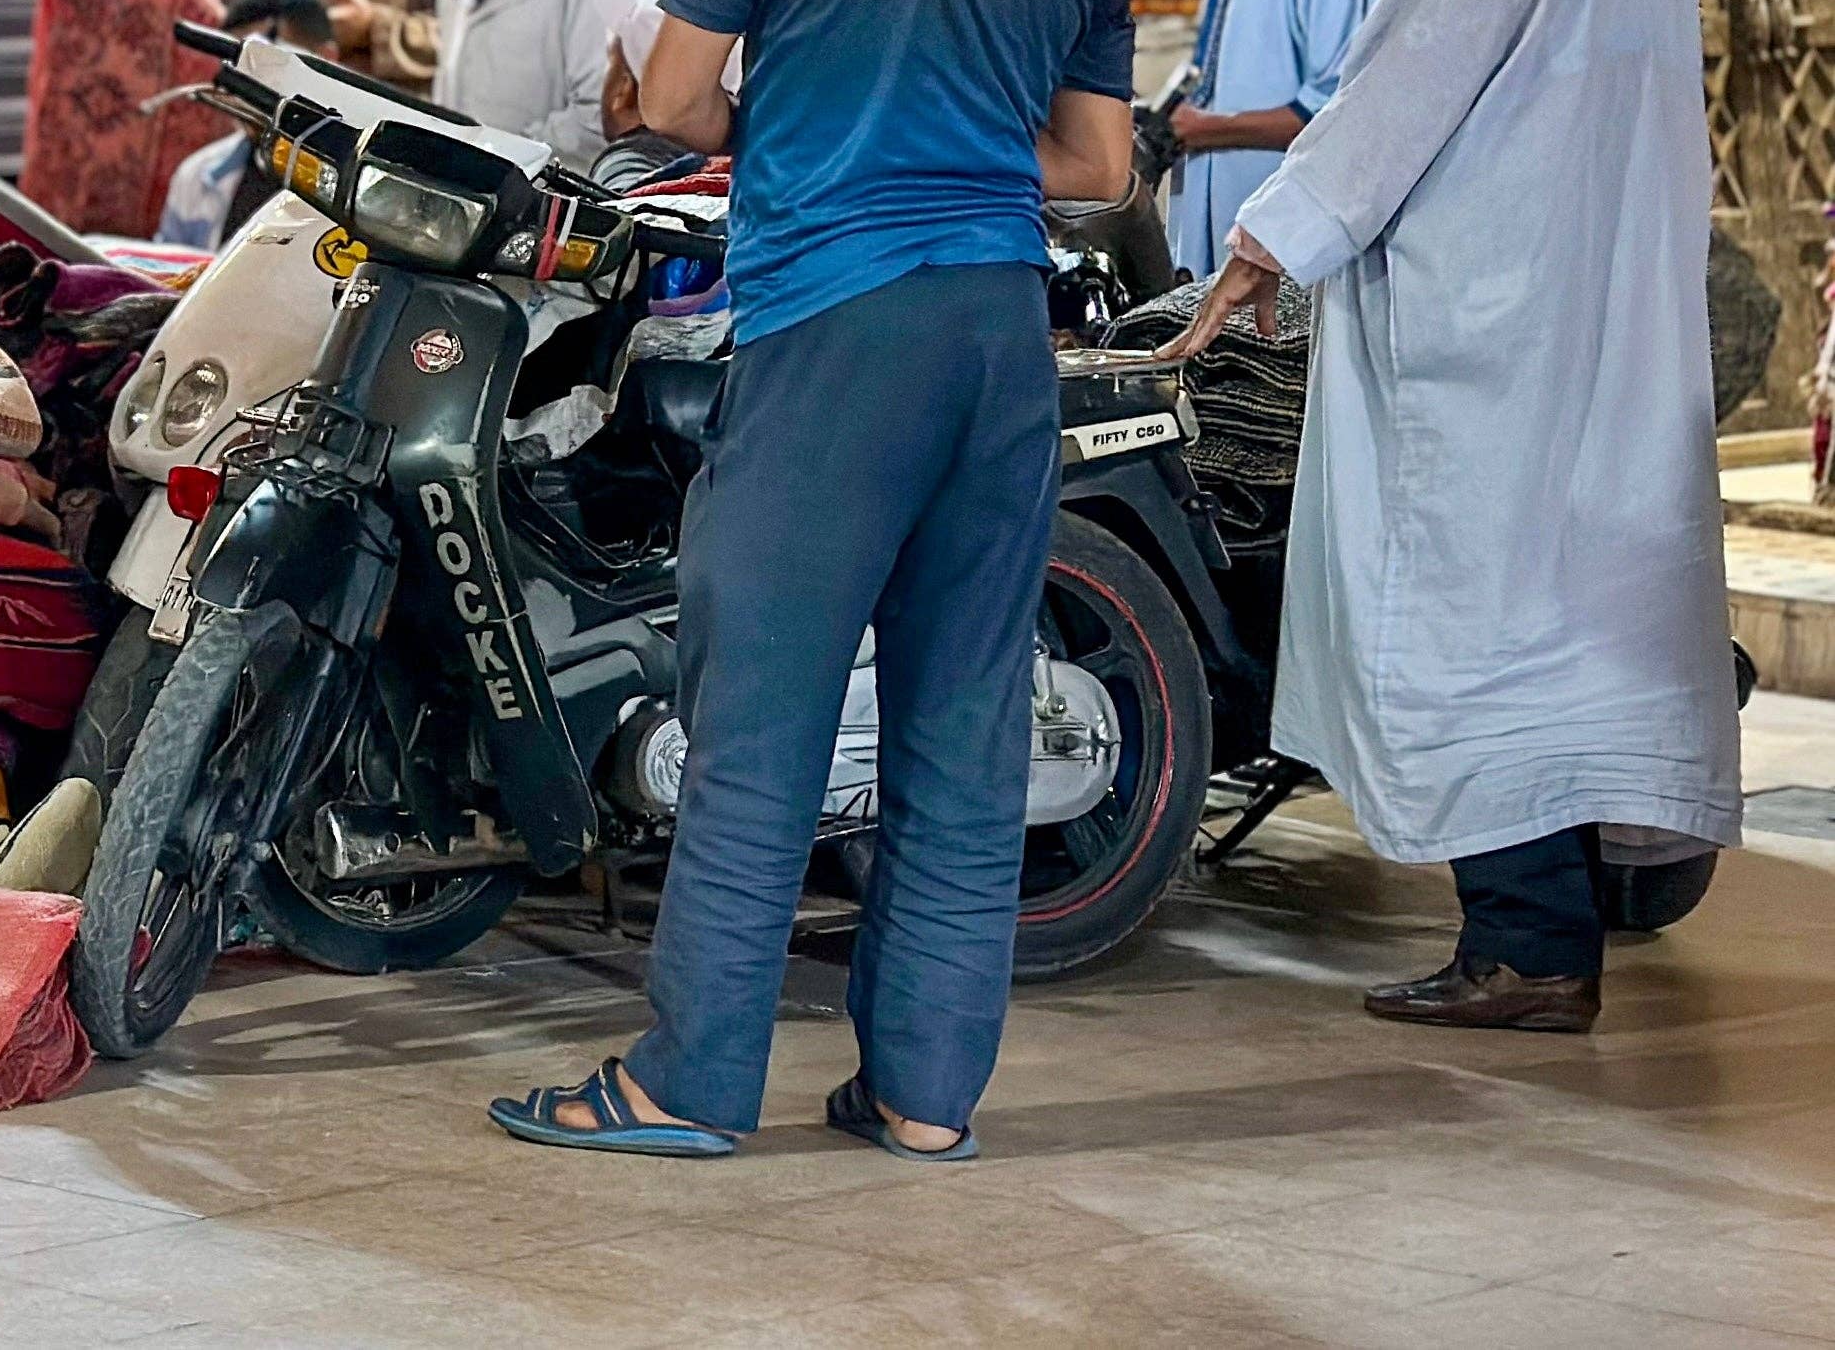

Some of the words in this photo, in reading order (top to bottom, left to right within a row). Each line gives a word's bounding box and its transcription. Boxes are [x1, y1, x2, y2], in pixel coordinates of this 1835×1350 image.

[1093, 429, 1129, 447] FIFTY
[1136, 424, 1165, 439] C50
[419, 482, 522, 720] DOCKE
